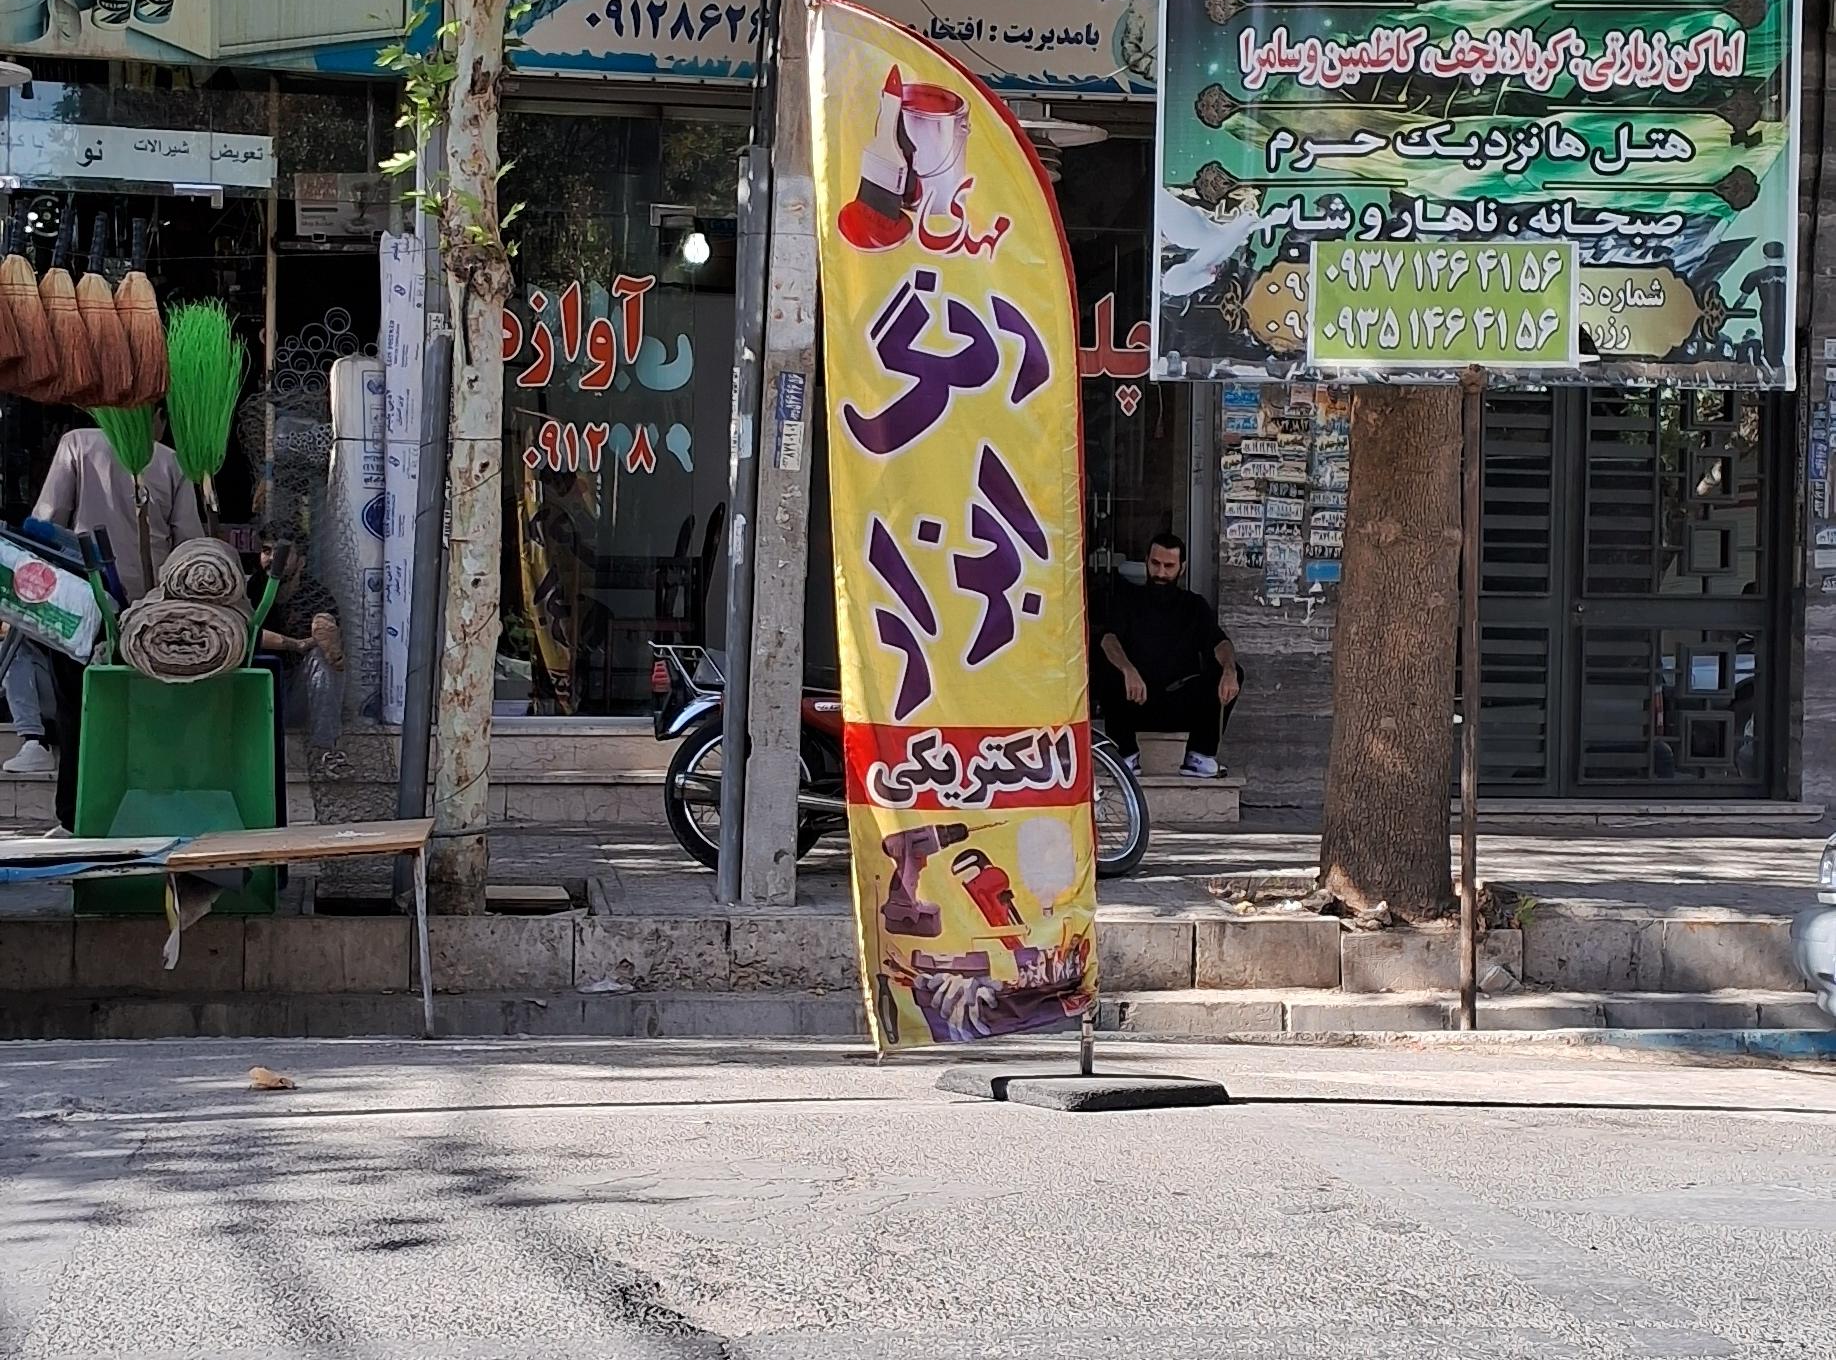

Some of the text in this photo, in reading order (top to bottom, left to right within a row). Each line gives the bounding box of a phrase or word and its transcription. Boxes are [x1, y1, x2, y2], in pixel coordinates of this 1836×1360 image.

[1239, 26, 1304, 90] سامرا
[1320, 26, 1428, 90] کاظمین
[1664, 27, 1748, 93] اماکن
[76, 139, 103, 168] نو
[133, 138, 190, 157] شیرالات
[210, 143, 264, 163] تعویض
[1267, 122, 1695, 172] هتل ها نزدیک حرم
[914, 176, 1012, 261] مهدی
[1357, 207, 1383, 239] و
[1391, 198, 1498, 239] ناهار
[1529, 201, 1684, 245] صبحانه
[1325, 247, 1564, 292] ۰۹۳۷ ۱۴۶ ۴۱ ۵۶
[1598, 277, 1666, 313] شماره
[502, 275, 657, 390] آوازه
[1322, 306, 1560, 351] ۰۹۳۵ ۱۴۶ ۴۱ ۵۶
[841, 268, 1050, 456] رنگ
[522, 421, 610, 472] ۰۹۱۲
[865, 442, 1053, 724] ابزار
[865, 725, 1078, 806] الکتریکی
